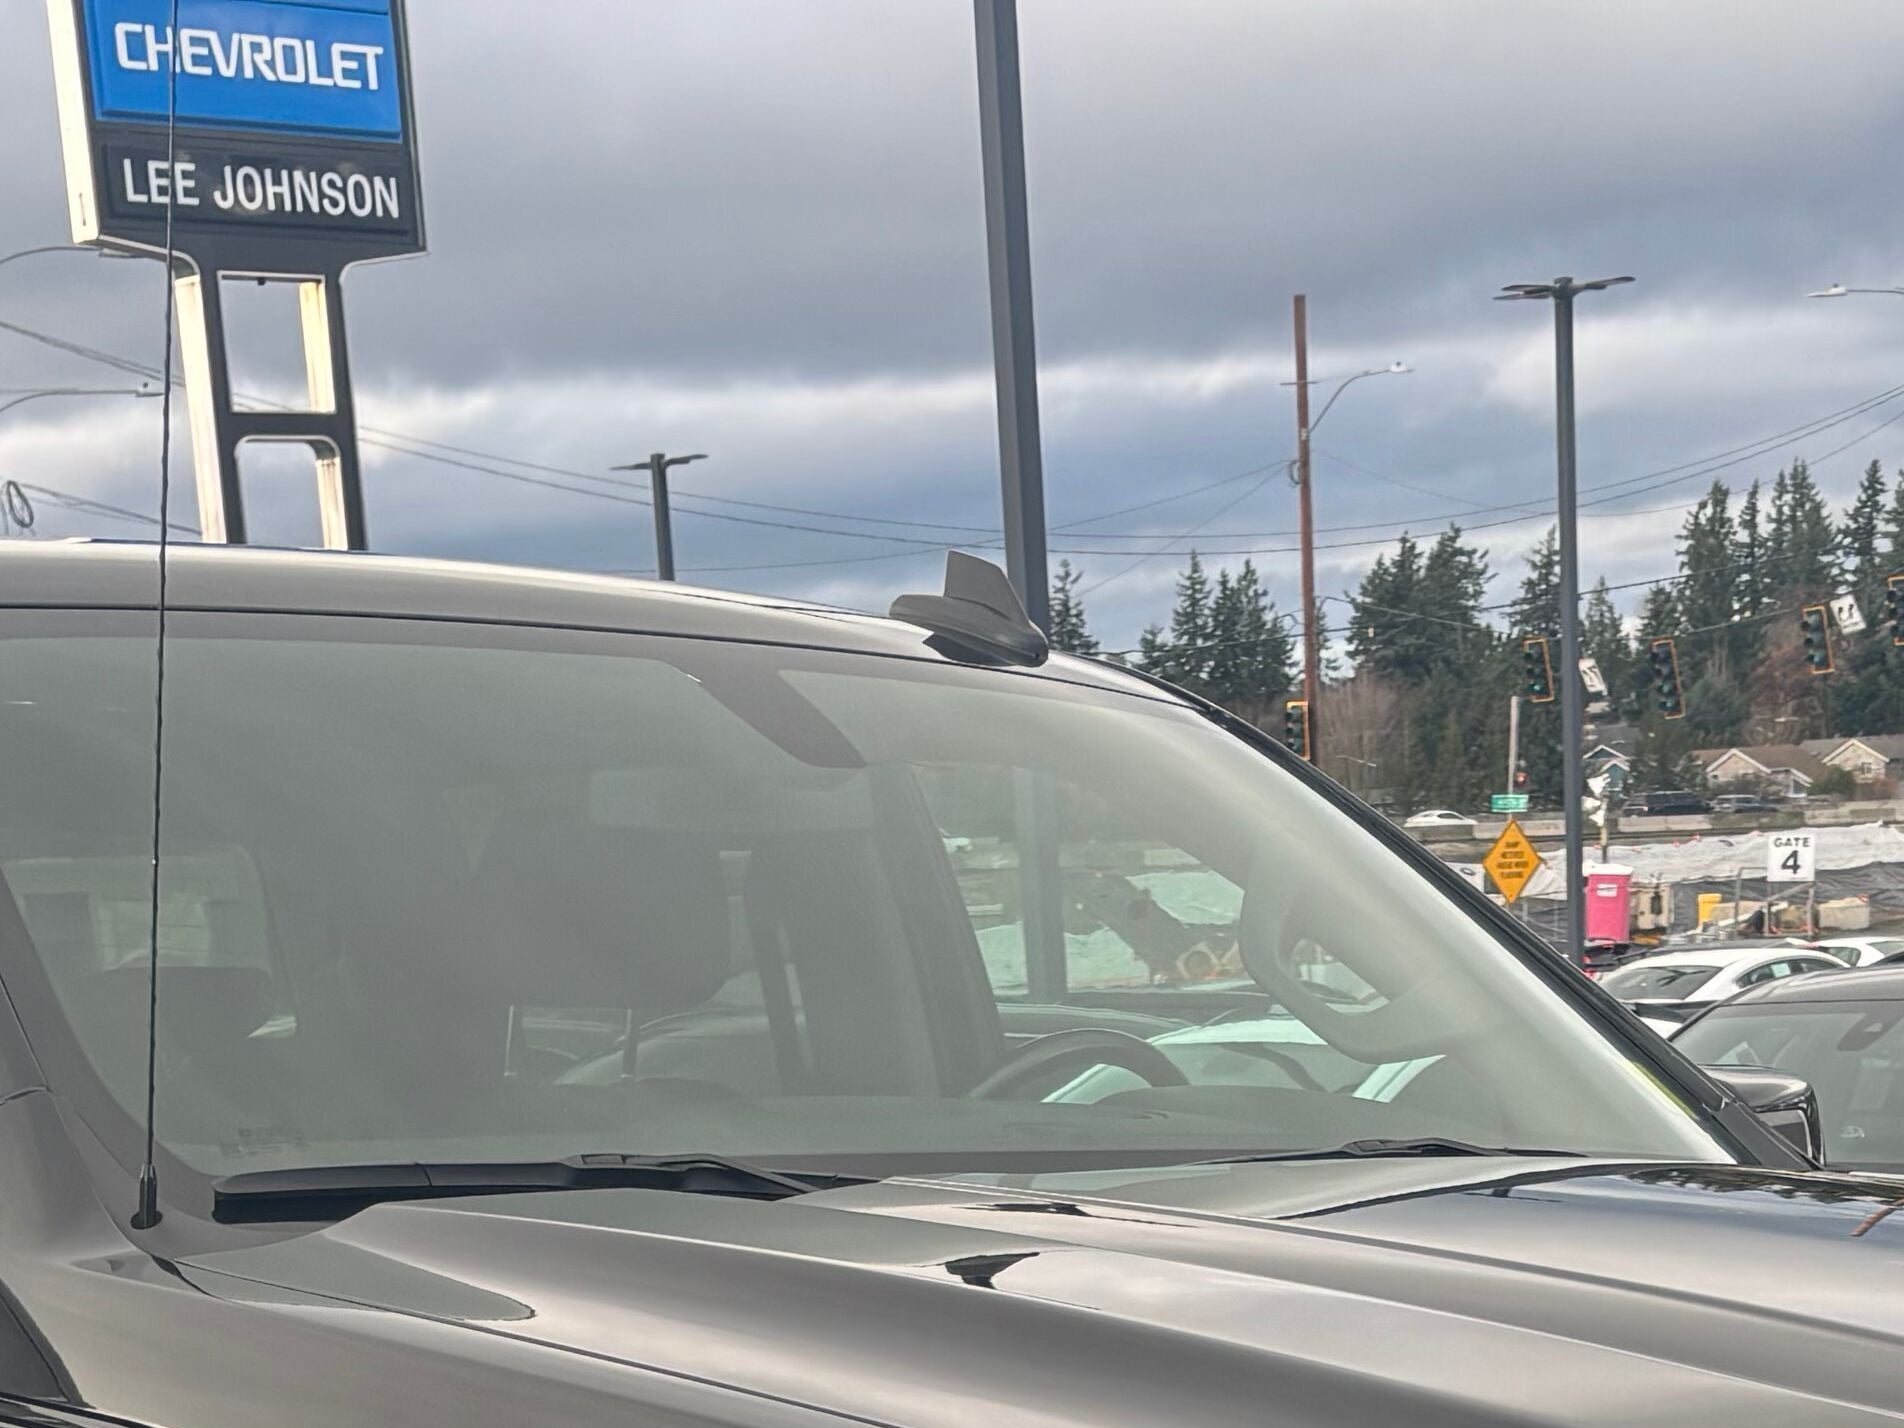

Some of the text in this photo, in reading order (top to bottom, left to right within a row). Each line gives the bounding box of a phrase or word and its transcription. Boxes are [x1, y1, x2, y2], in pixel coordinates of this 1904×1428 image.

[115, 21, 384, 91] CHEVROLET
[123, 157, 399, 219] LEE JOHNSON
[1773, 836, 1811, 848] GATE
[1780, 849, 1803, 875] 4
